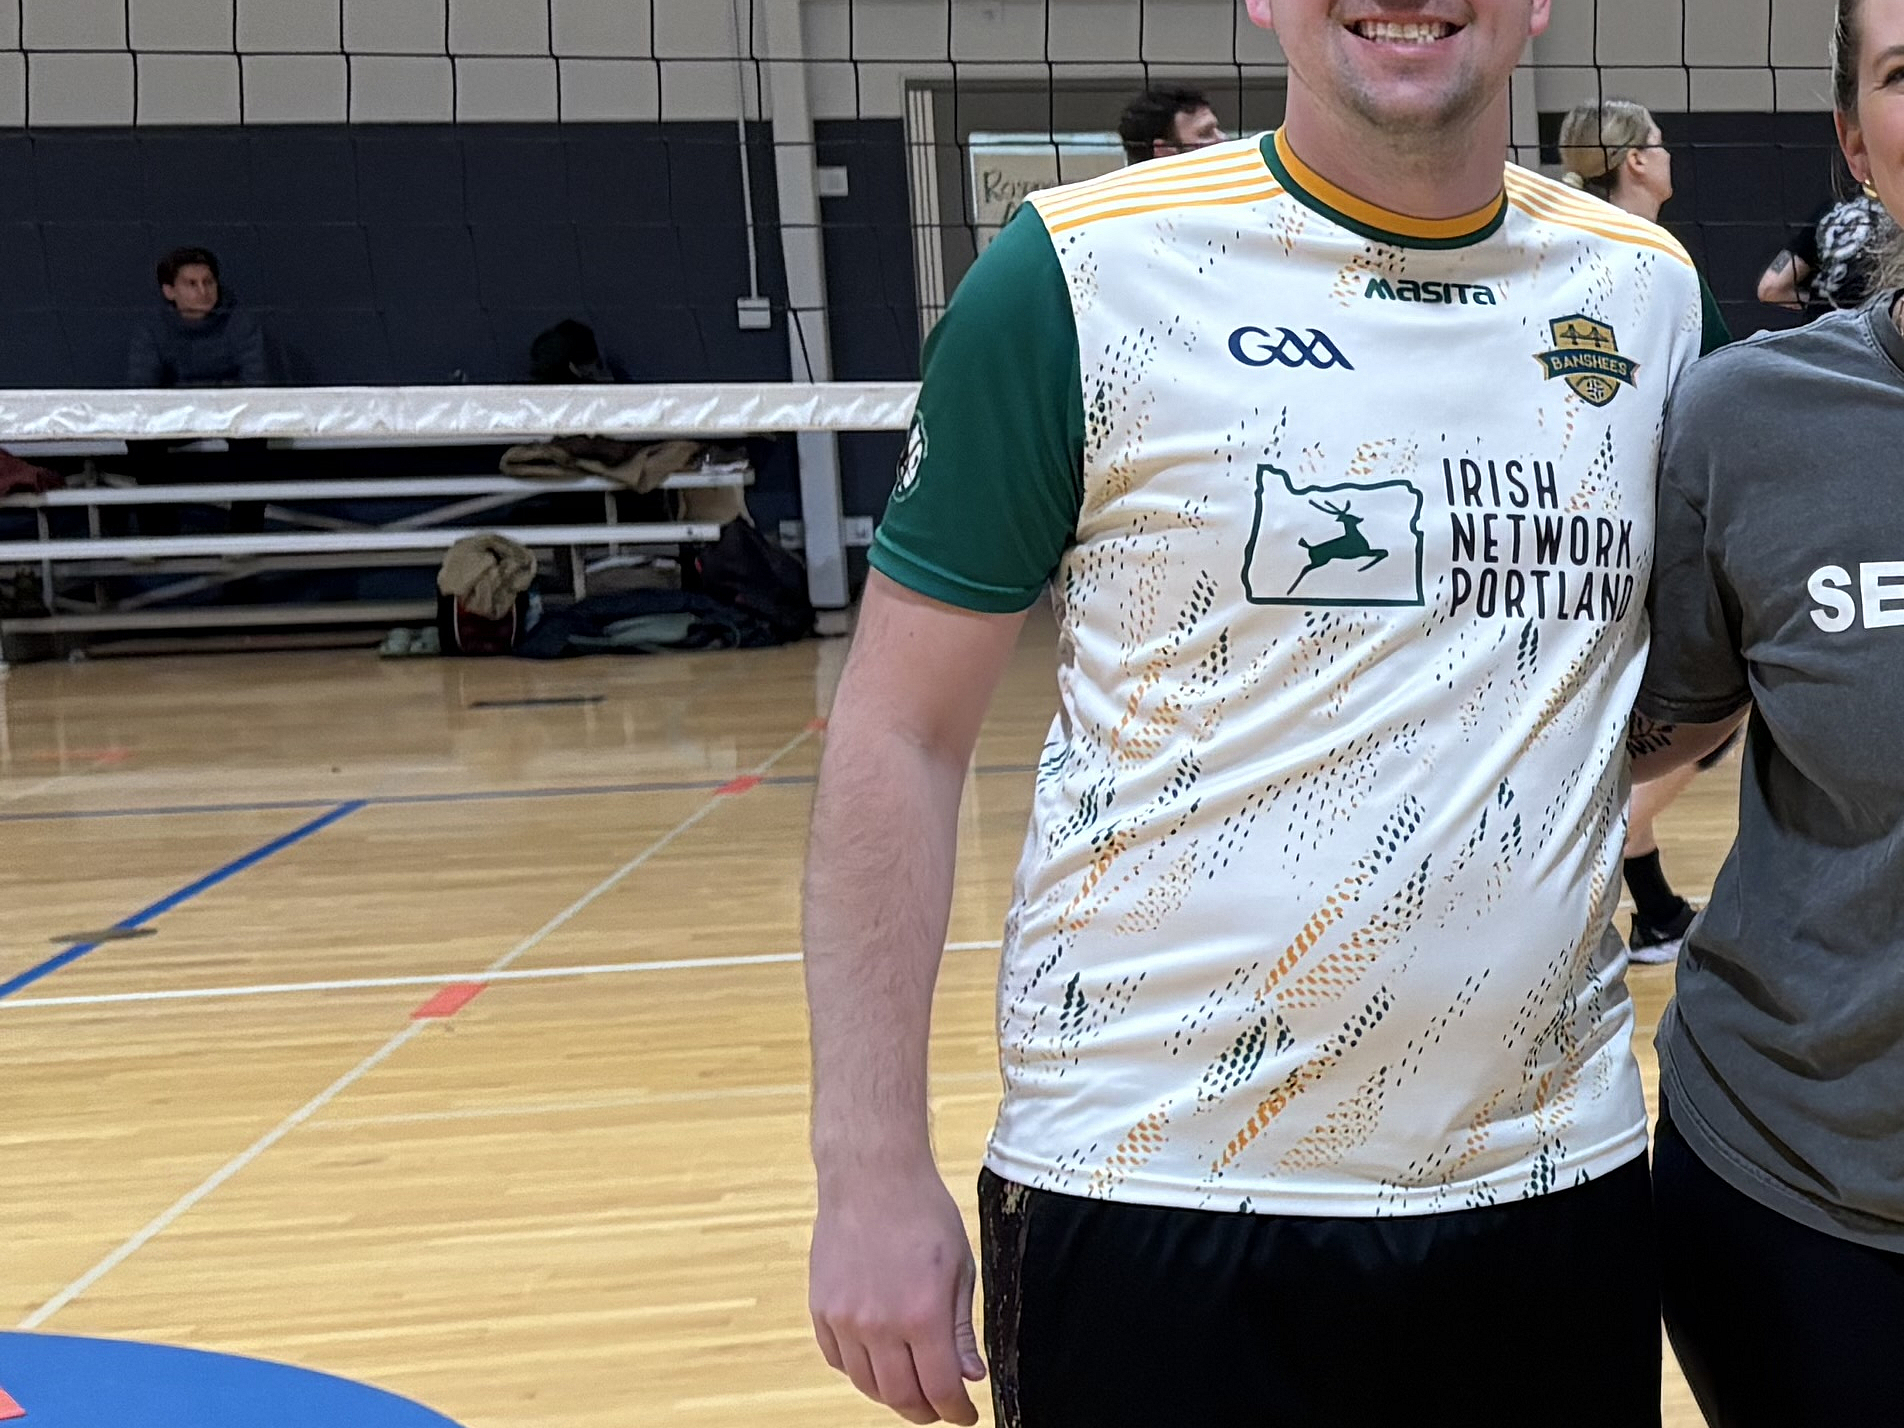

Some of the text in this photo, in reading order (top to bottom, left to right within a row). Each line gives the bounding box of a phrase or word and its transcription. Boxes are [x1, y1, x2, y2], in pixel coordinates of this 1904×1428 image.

[1550, 353, 1628, 377] BANSHEES
[1442, 457, 1560, 510] IRISH
[1449, 511, 1633, 570] NETWORK
[1449, 566, 1634, 623] PORTLAND
